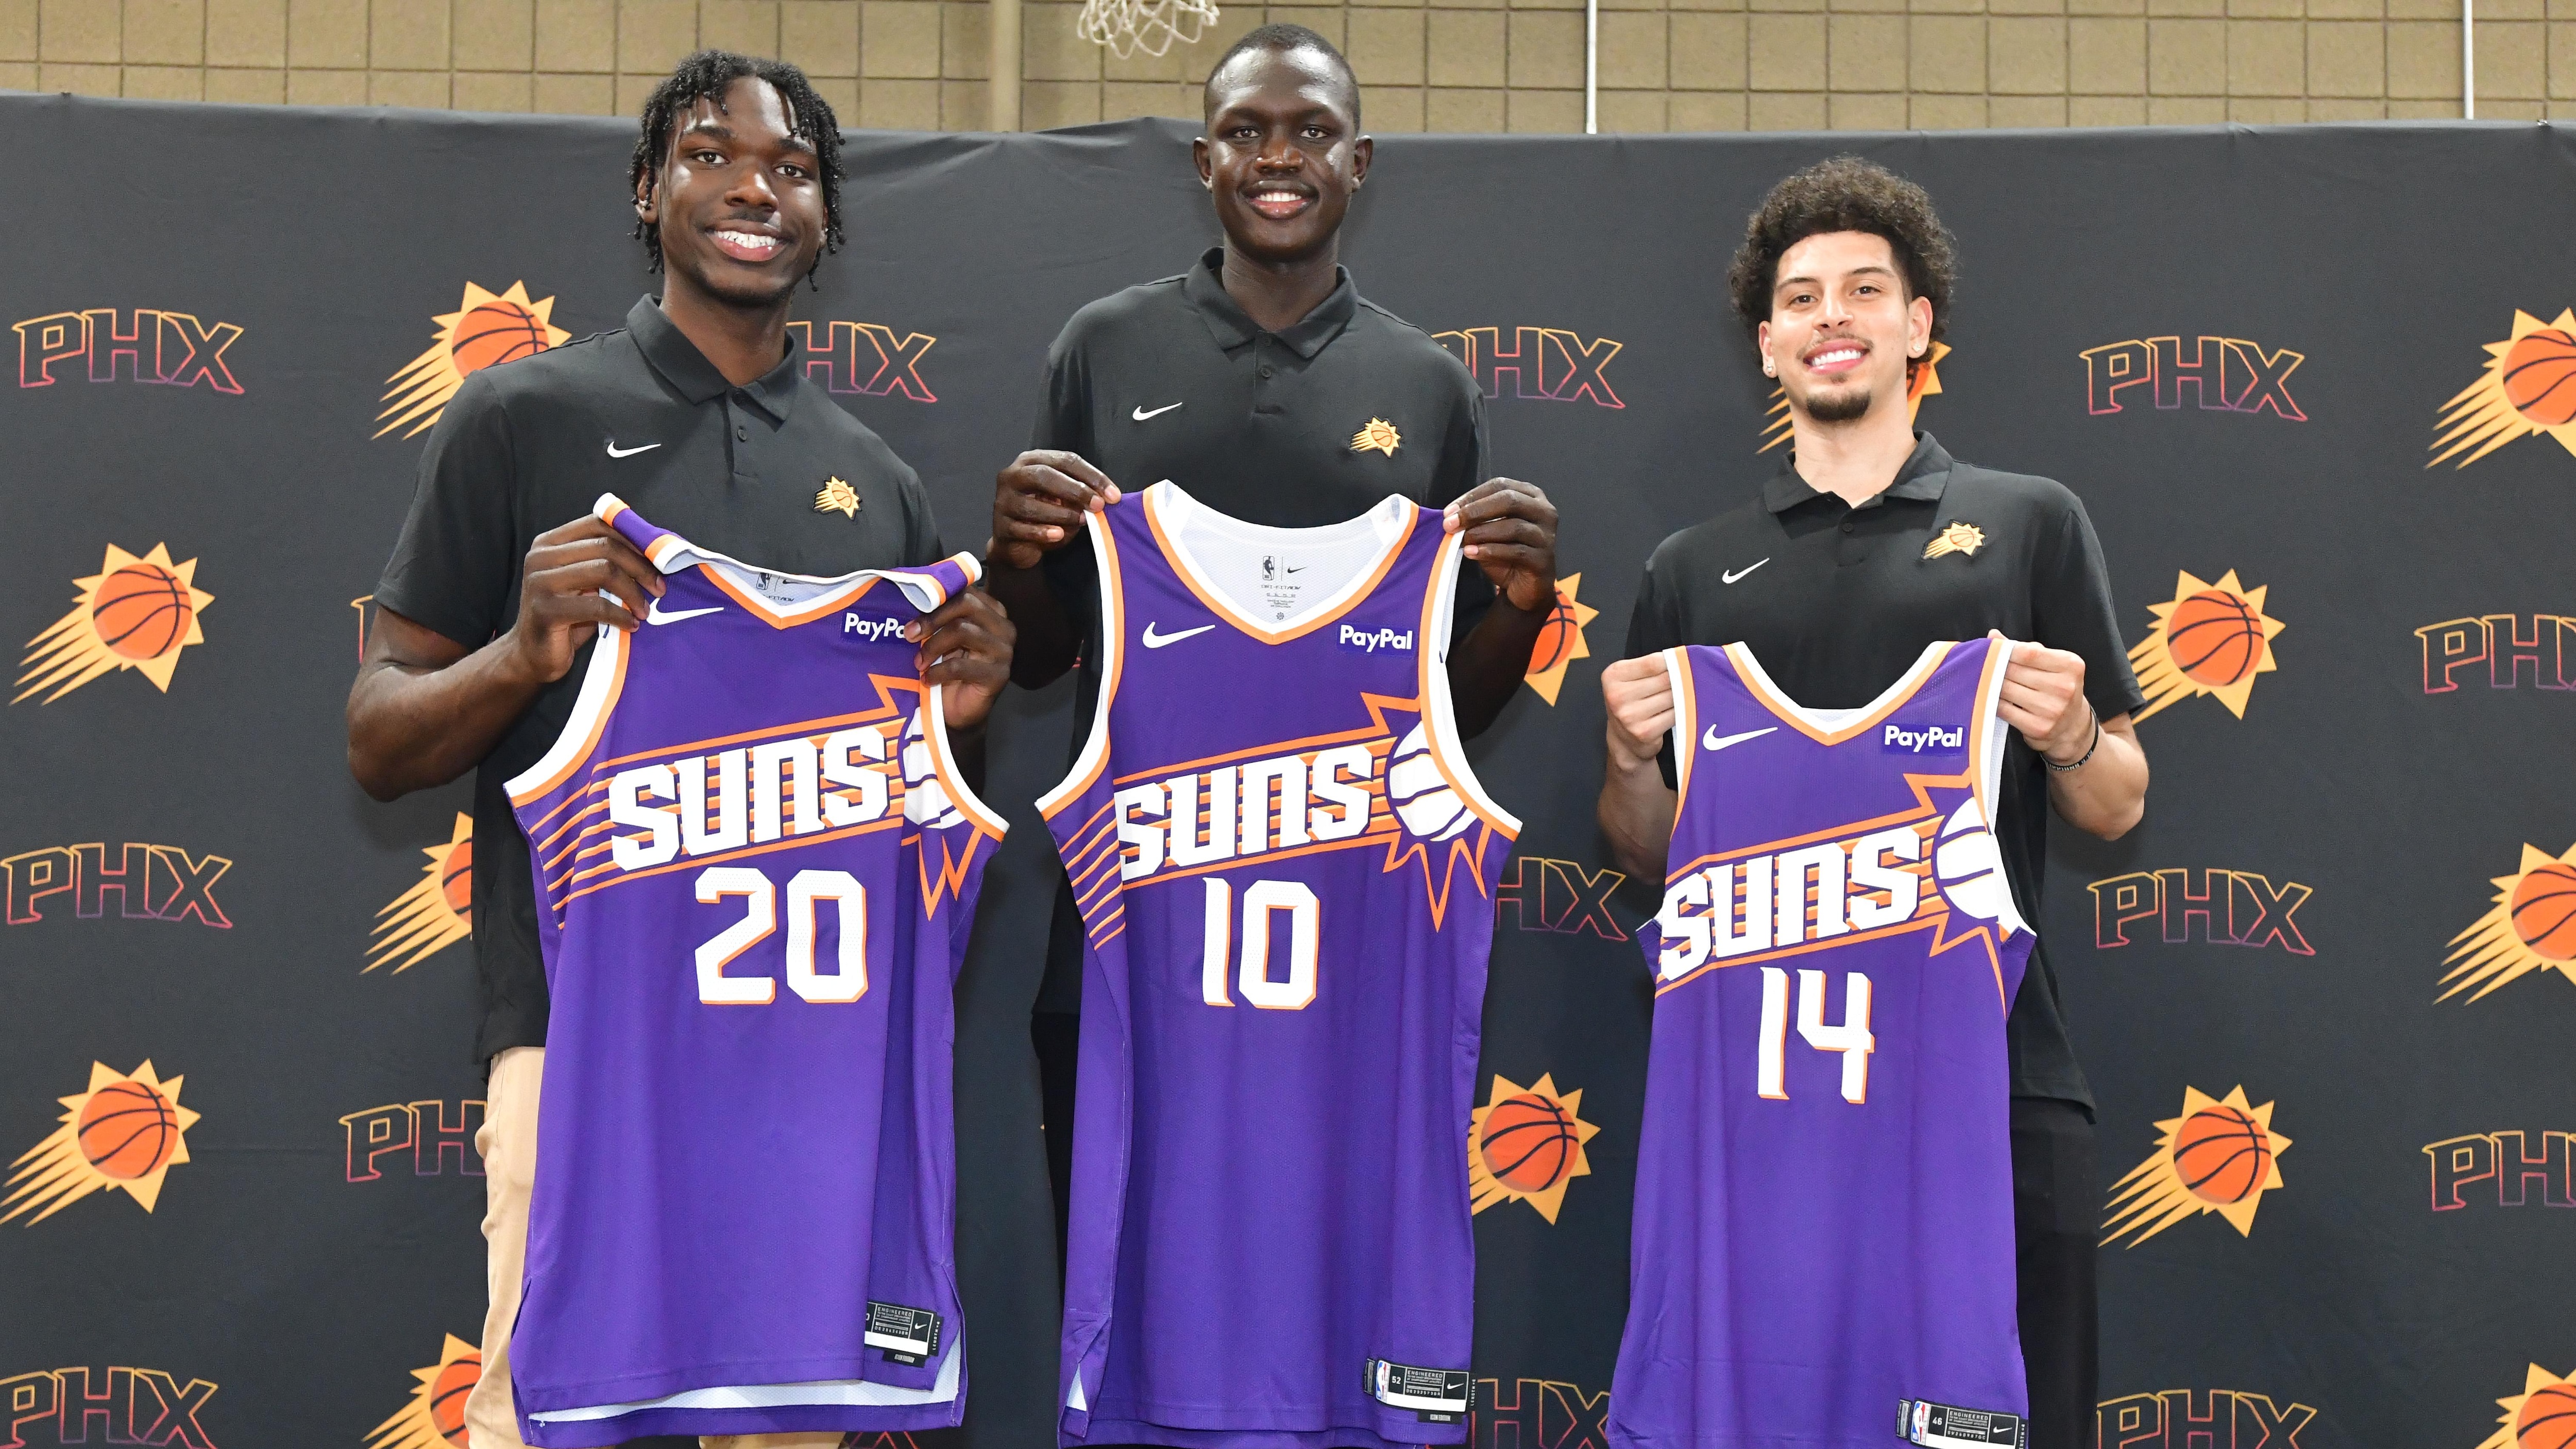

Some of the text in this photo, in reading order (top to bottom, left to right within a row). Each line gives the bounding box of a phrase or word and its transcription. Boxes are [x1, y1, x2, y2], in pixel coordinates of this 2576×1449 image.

[11, 308, 245, 395] PHX
[786, 321, 938, 403] HX
[2079, 335, 2308, 422] PHX
[844, 612, 906, 642] PayPa
[1340, 624, 1413, 653] PayPal
[2414, 613, 2576, 694] PH
[1884, 724, 1963, 753] PayPal
[609, 726, 890, 872] SUNS
[1114, 744, 1372, 881] SUNS
[0, 841, 233, 929] PHX
[1497, 856, 1629, 941] HX
[1658, 825, 1922, 982] SUNS
[2087, 868, 2316, 956] PHX
[694, 866, 869, 1005] 20
[1201, 877, 1320, 1010] 10
[1757, 966, 1875, 1104] 14
[338, 1099, 487, 1183] PH
[2421, 1130, 2576, 1211] PH
[877, 1306, 912, 1318] ENGINEERED
[0, 1366, 218, 1449] PHX
[1392, 1376, 1401, 1385] 52
[1407, 1370, 1443, 1378] ENGINEERED
[1470, 1378, 1610, 1449] HX
[1932, 1417, 1943, 1426] 46
[1949, 1410, 1989, 1421] ENGINEERED
[2098, 1389, 2317, 1449] PHX
